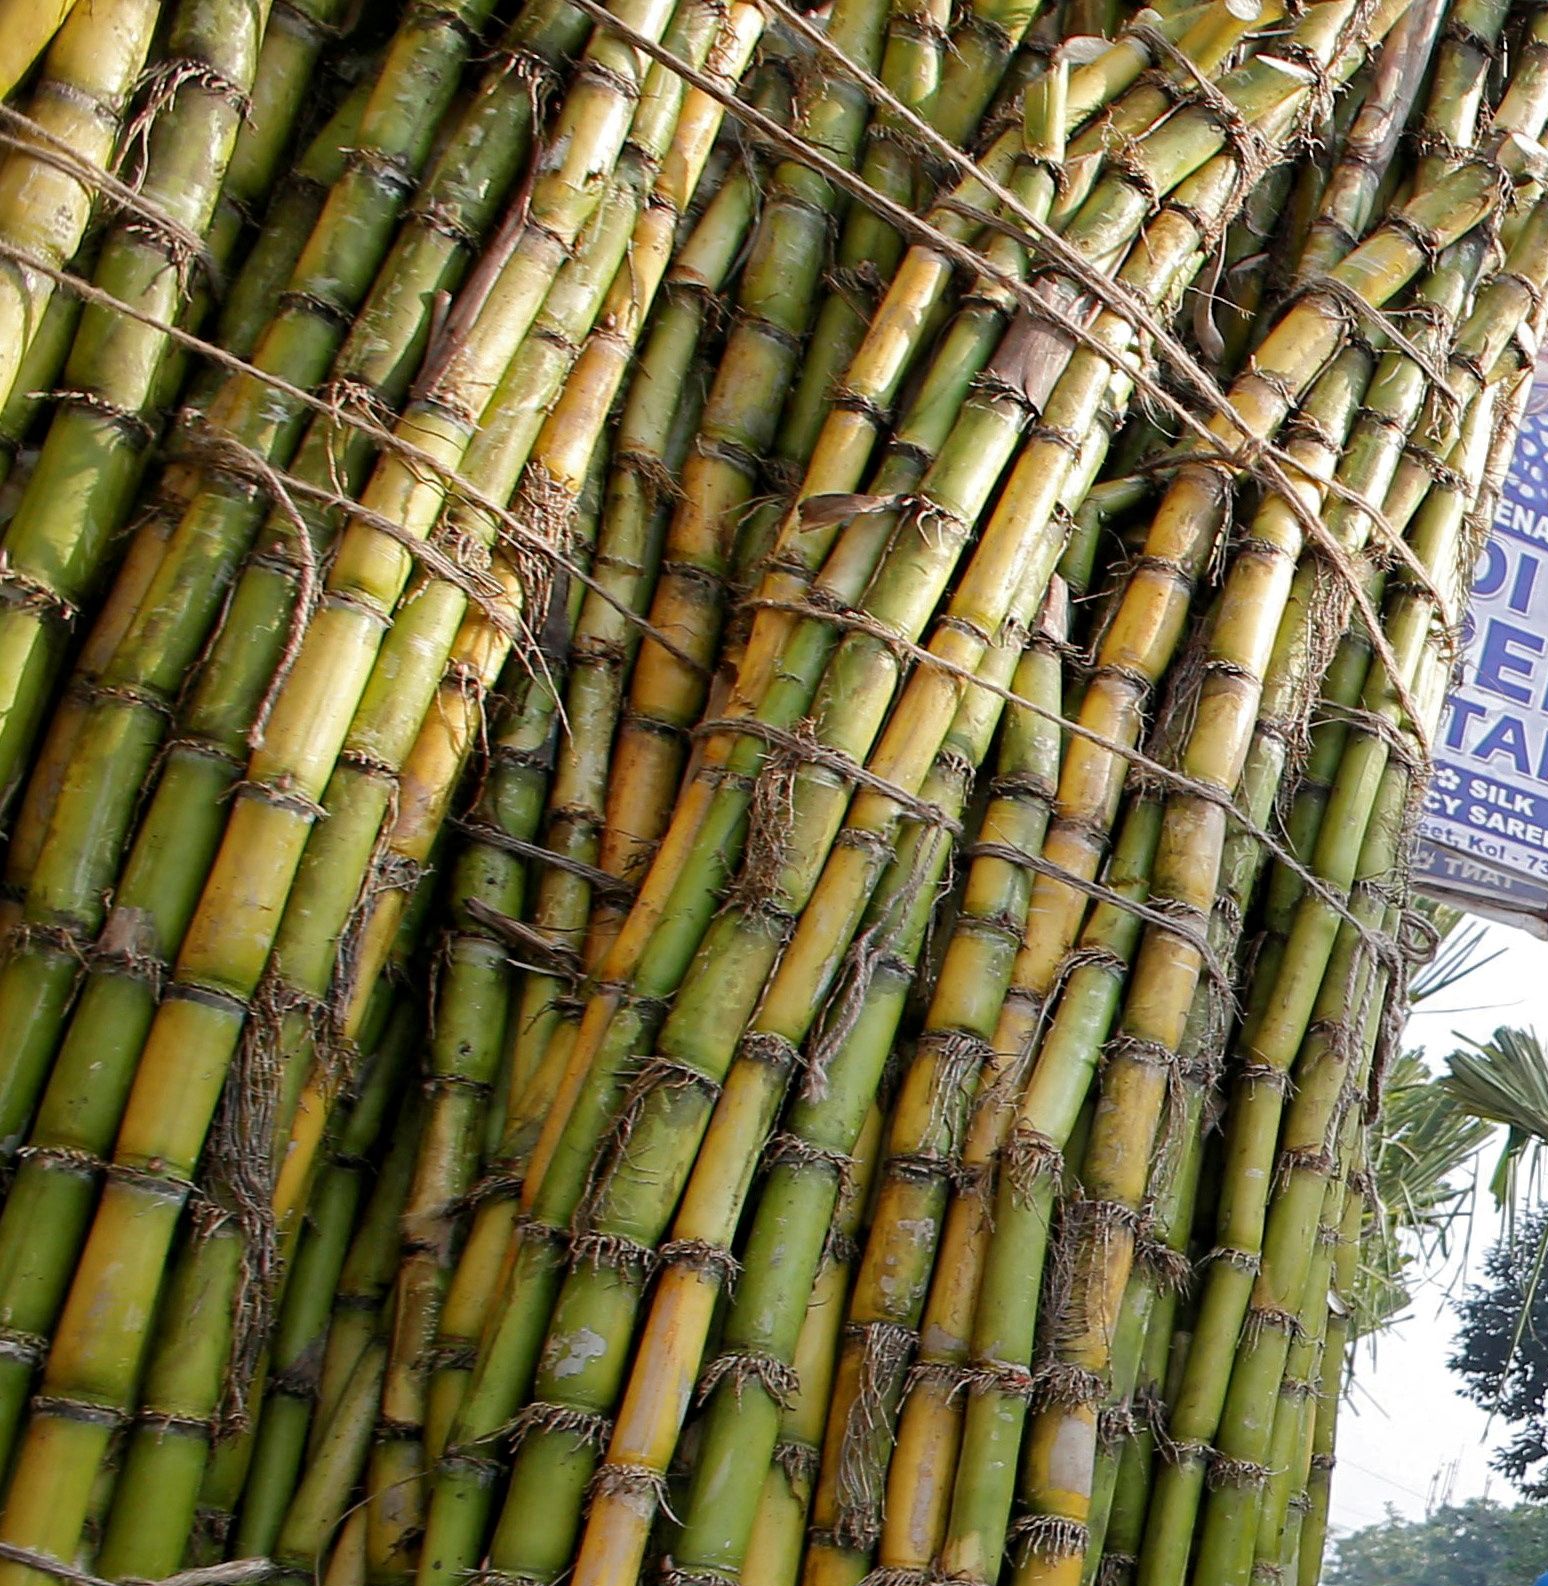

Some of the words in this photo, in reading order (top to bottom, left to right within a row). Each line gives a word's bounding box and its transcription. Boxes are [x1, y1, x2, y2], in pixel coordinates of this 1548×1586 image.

[1422, 790, 1462, 816] CY
[1468, 779, 1535, 817] SILK
[1417, 821, 1459, 847] eet,
[1468, 834, 1506, 861] Kol
